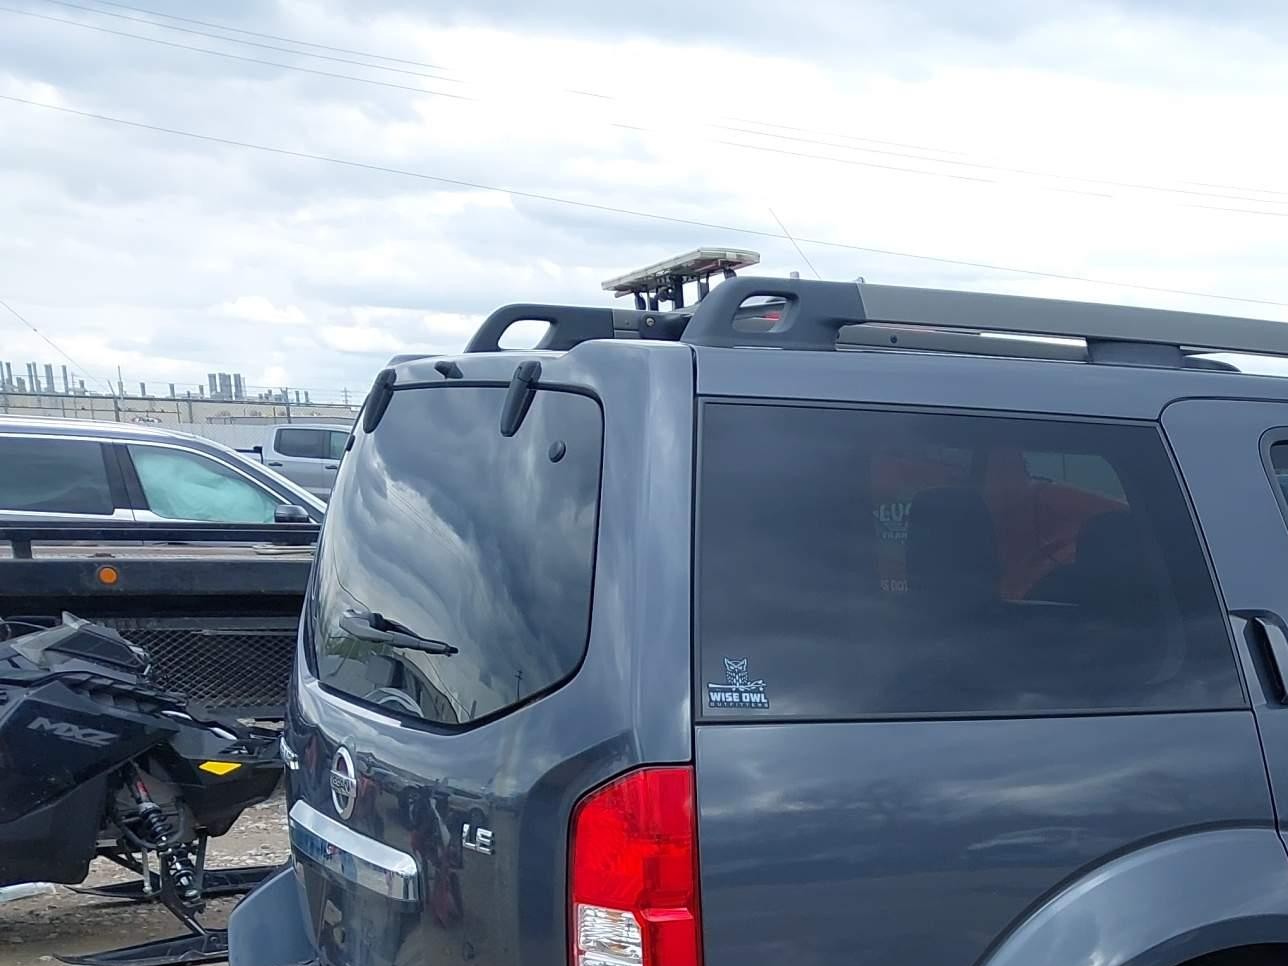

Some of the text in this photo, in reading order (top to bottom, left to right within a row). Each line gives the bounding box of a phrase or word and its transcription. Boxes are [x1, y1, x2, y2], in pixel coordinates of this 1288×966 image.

[710, 692, 767, 703] WISE OWL
[26, 716, 120, 747] MXZ
[462, 823, 493, 855] LE
